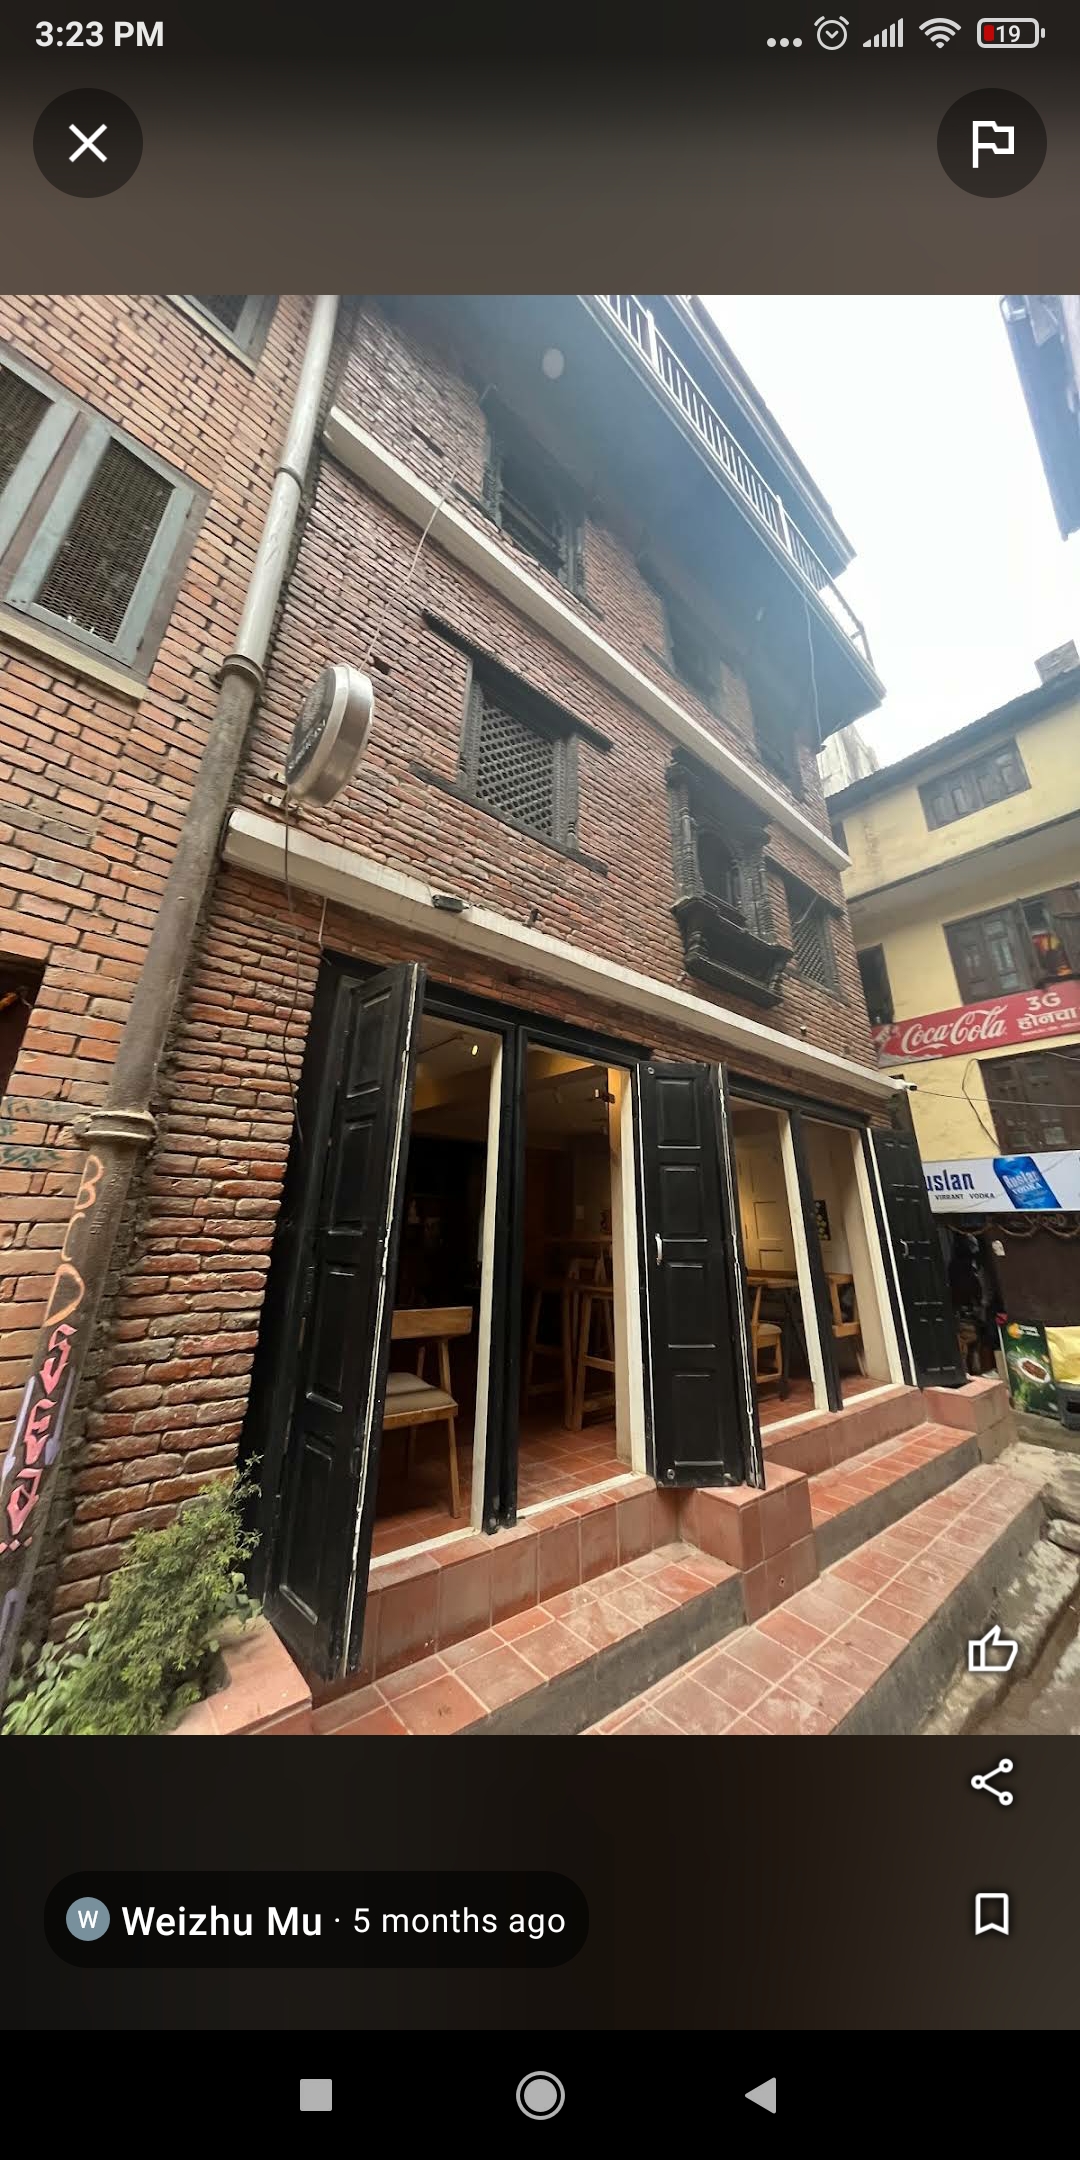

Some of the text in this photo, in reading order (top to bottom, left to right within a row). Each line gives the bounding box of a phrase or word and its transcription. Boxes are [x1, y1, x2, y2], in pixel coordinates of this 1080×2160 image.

[1025, 992, 1062, 1011] 3G
[901, 1004, 1008, 1055] Coca-Cola
[924, 1169, 975, 1192] uslan
[934, 1192, 996, 1201] VIBRANT VODKA
